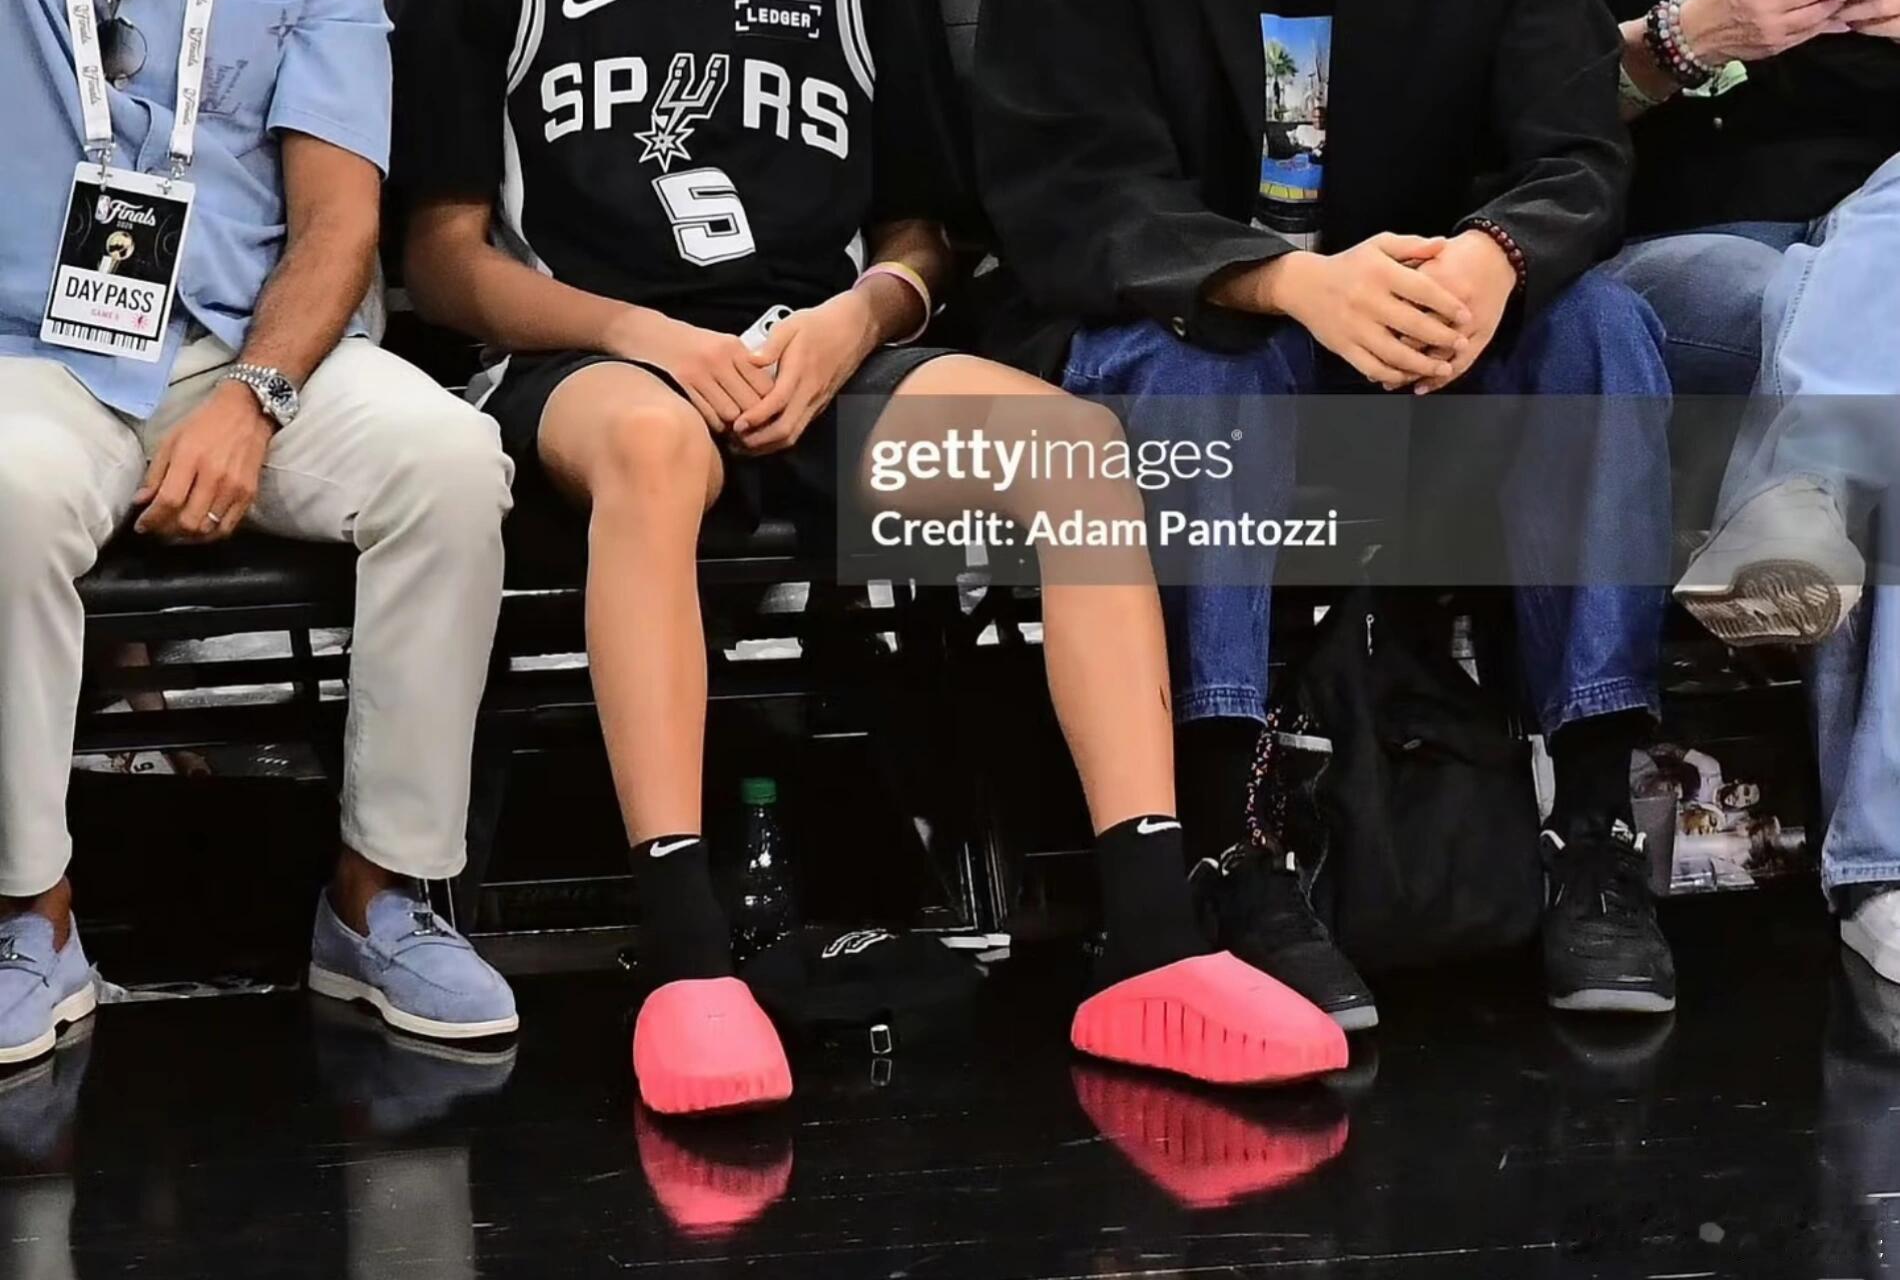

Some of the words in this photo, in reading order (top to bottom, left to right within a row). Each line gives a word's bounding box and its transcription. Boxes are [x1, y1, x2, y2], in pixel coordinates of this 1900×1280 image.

[73, 4, 92, 45] Finals
[746, 7, 812, 29] LEDGER
[187, 27, 204, 68] Finals
[82, 65, 101, 106] Finals
[100, 198, 157, 228] Finals
[651, 166, 756, 267] 5
[65, 276, 104, 303] DAY
[104, 284, 155, 314] PASS
